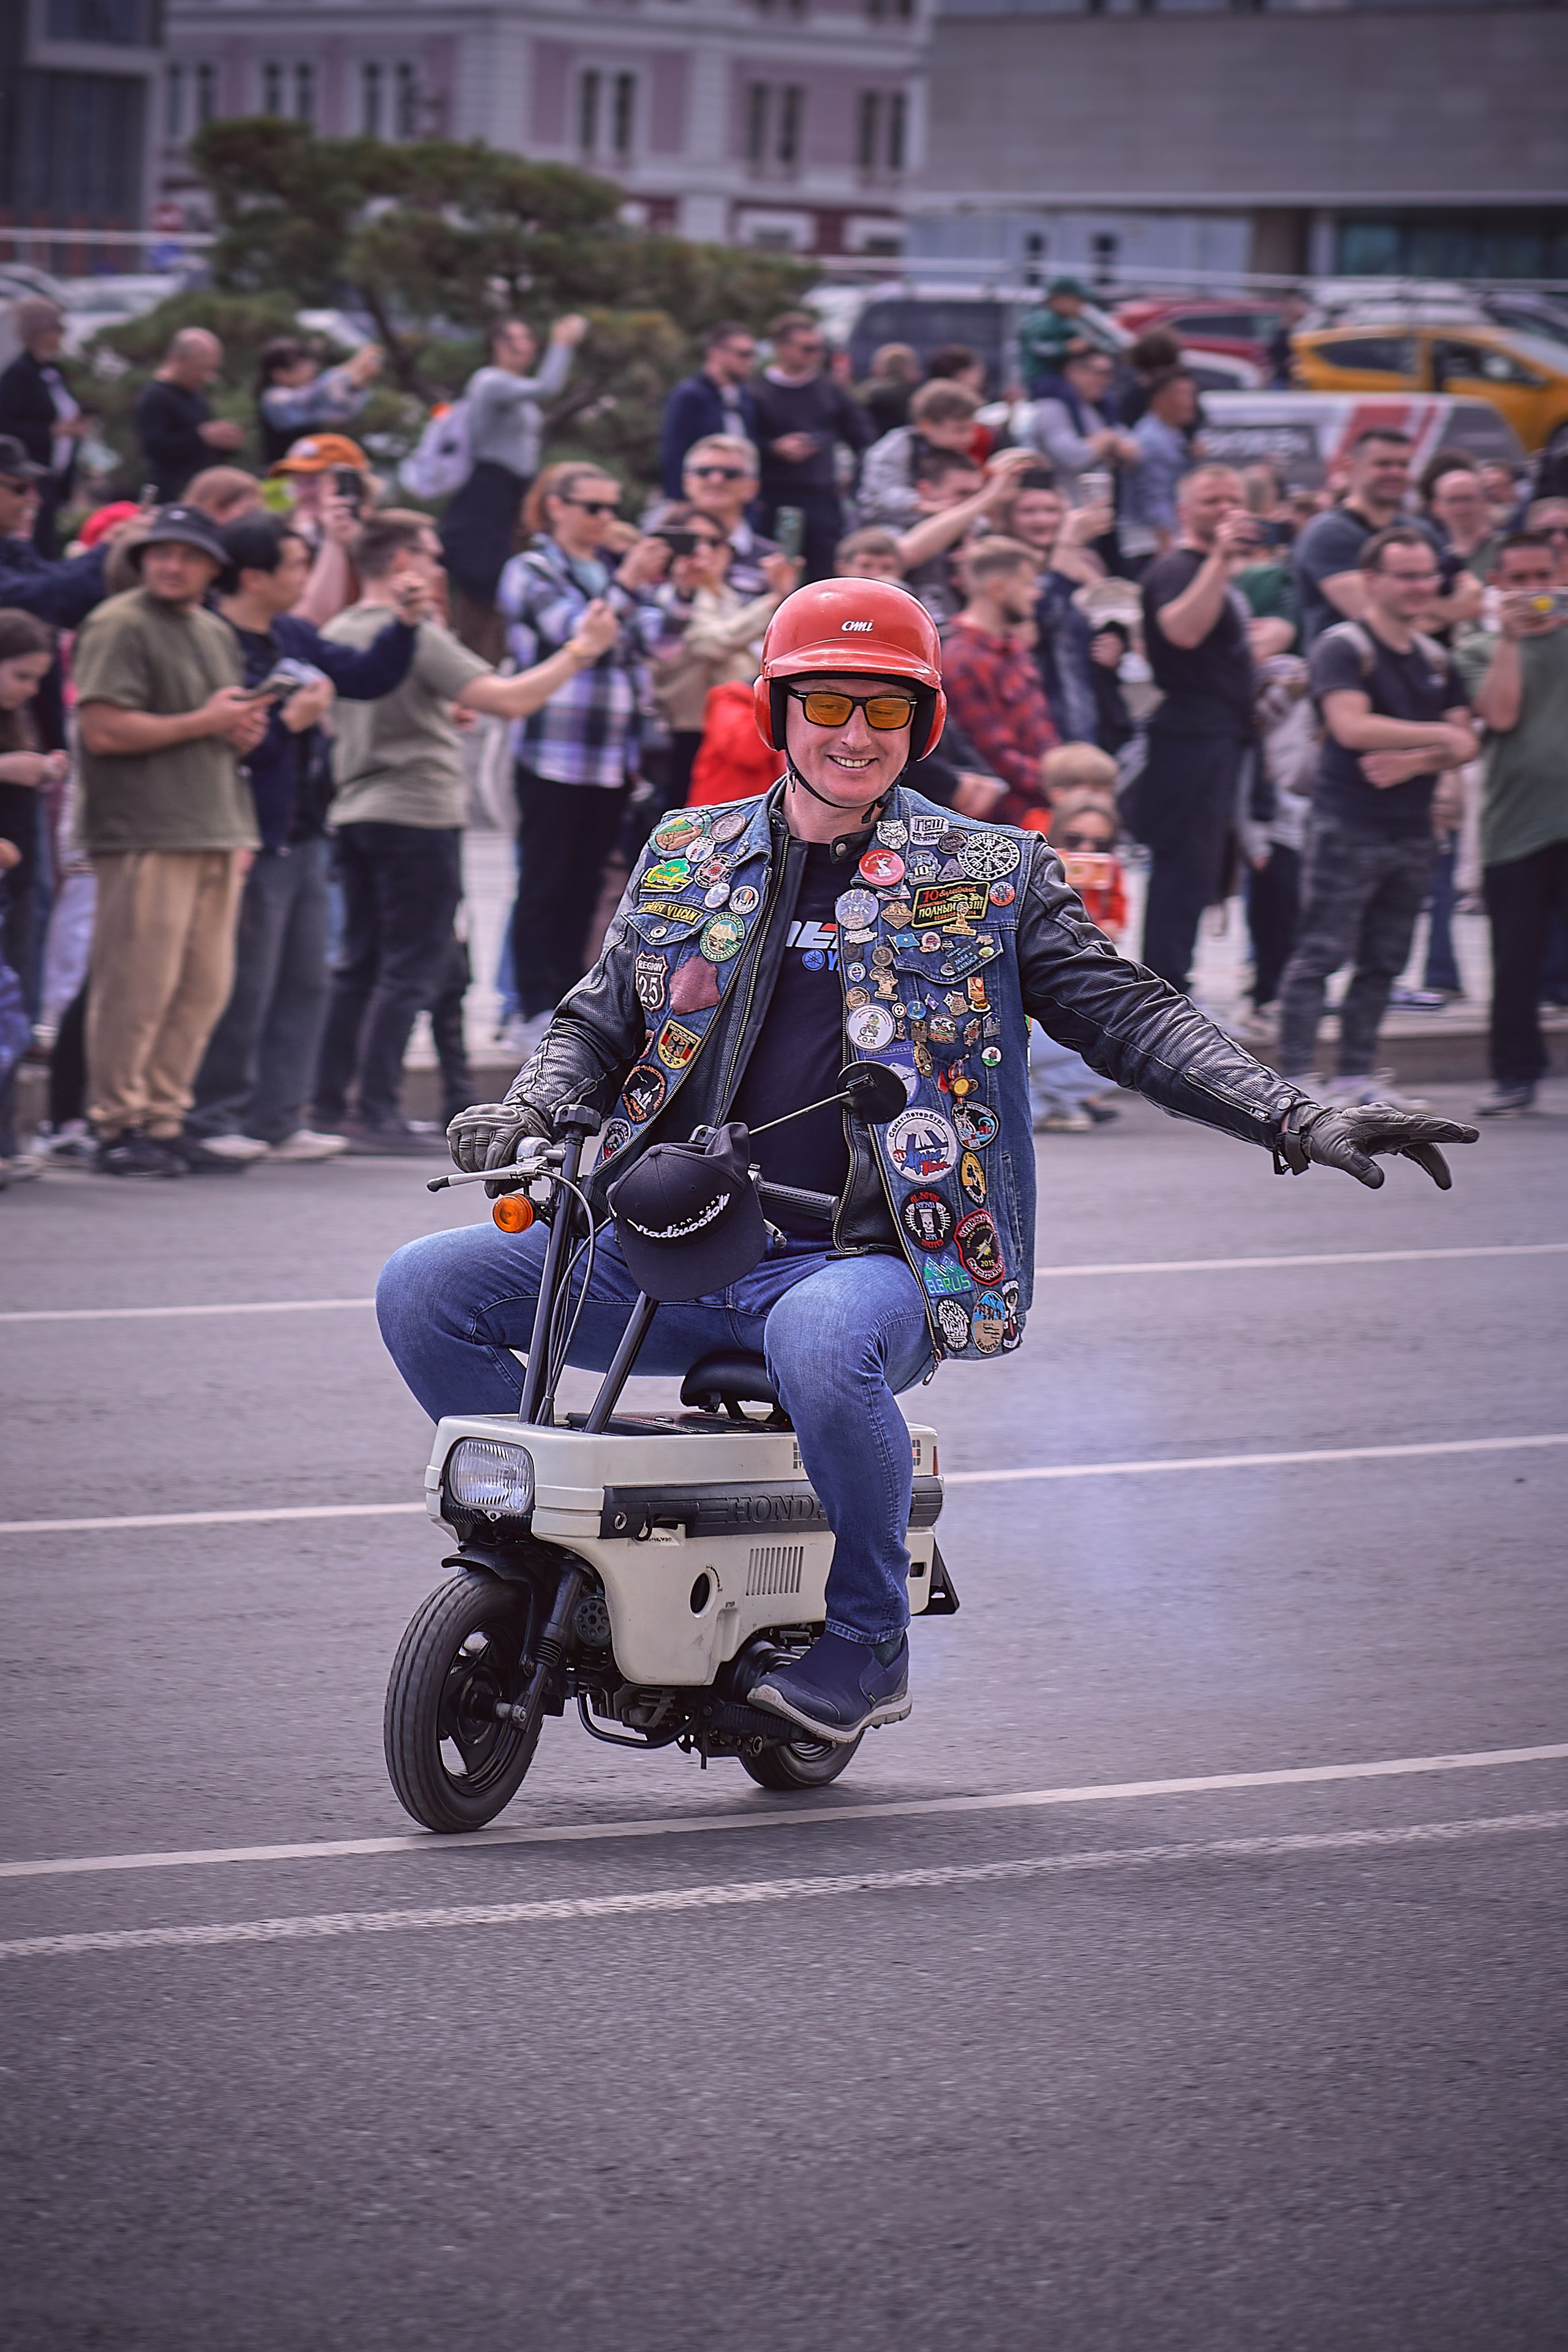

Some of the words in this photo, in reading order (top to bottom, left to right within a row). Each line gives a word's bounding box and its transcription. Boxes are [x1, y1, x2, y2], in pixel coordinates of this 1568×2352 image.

[914, 865, 929, 876] 10
[922, 889, 939, 903] 10
[934, 911, 957, 921] КЕМЕРОВ
[638, 959, 663, 972] REGION
[638, 975, 658, 1005] 25
[889, 1112, 946, 1137] Санкт-Петербург
[919, 1159, 952, 1176] Twin
[925, 1273, 971, 1294] ELBRUS
